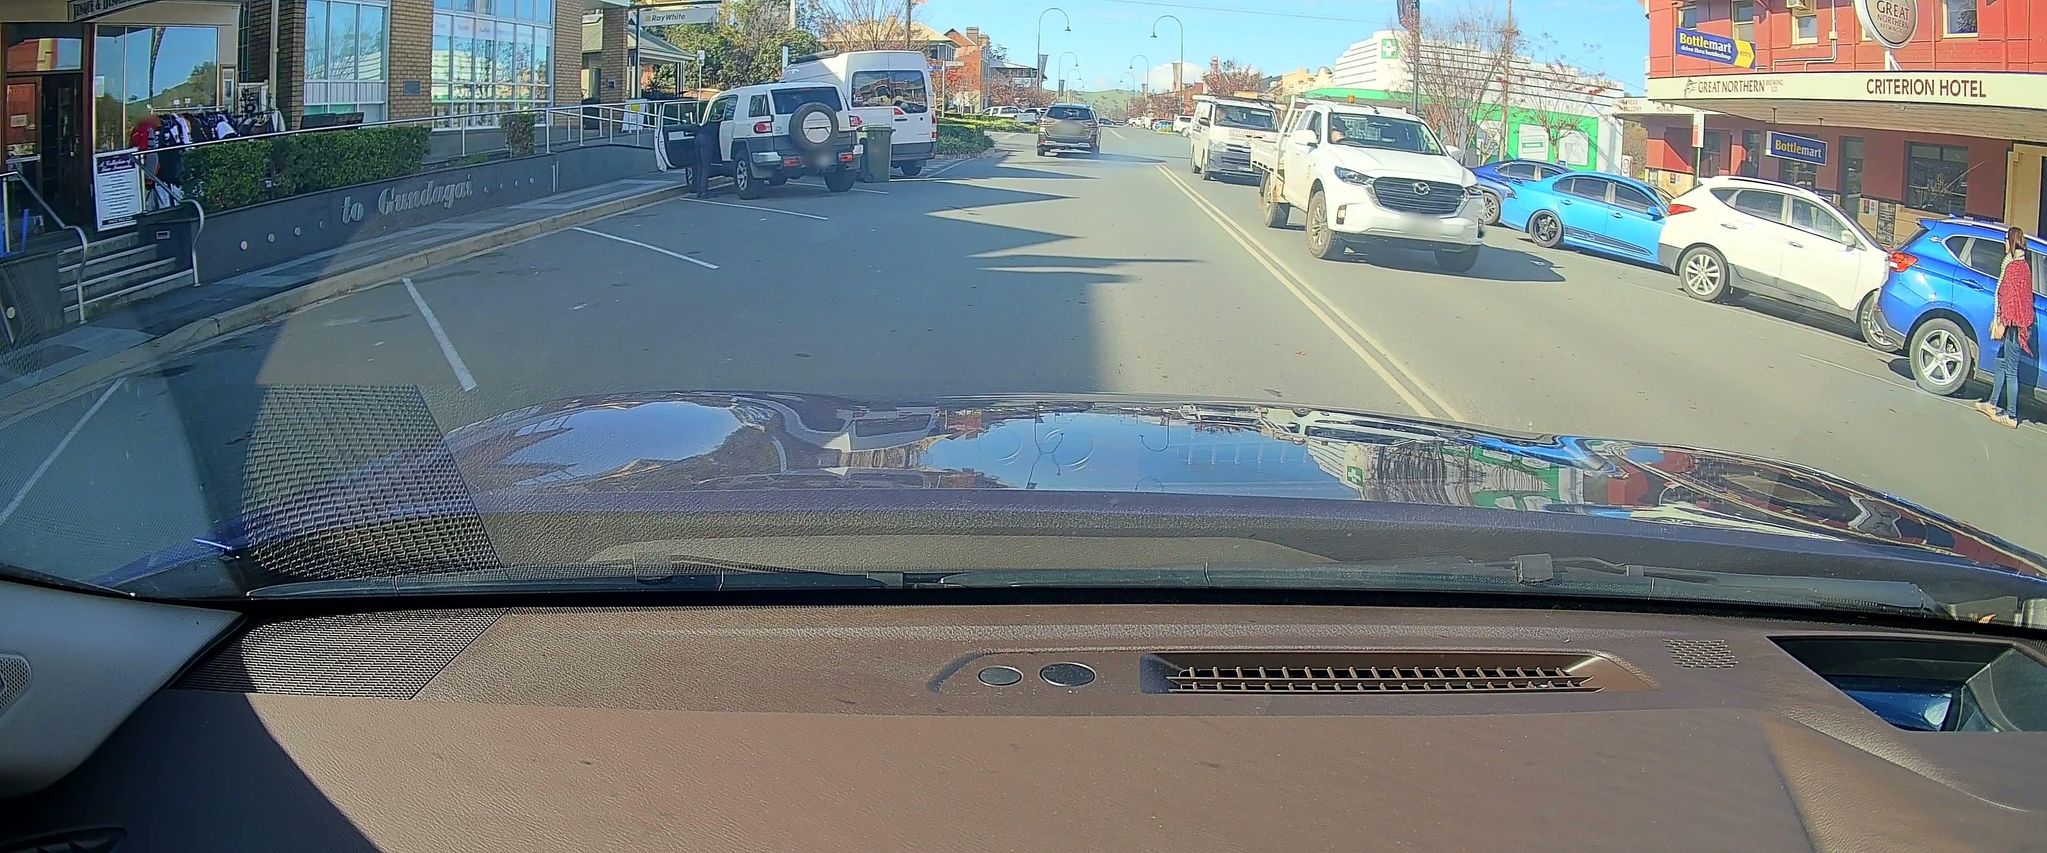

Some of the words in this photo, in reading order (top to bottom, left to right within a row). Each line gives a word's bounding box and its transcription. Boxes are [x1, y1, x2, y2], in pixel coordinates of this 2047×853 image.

[1877, 0, 1910, 21] GREAT
[1877, 14, 1909, 29] NORTHERN
[1680, 33, 1732, 53] Bottlemart
[1698, 81, 1720, 93] GREAT
[1722, 80, 1765, 92] NORTHERN
[1866, 78, 1935, 96] CRITERION
[1940, 80, 1987, 98] HOTEL
[1775, 139, 1824, 158] Bottlemart
[341, 196, 364, 224] to
[378, 173, 473, 215] Gundagai
